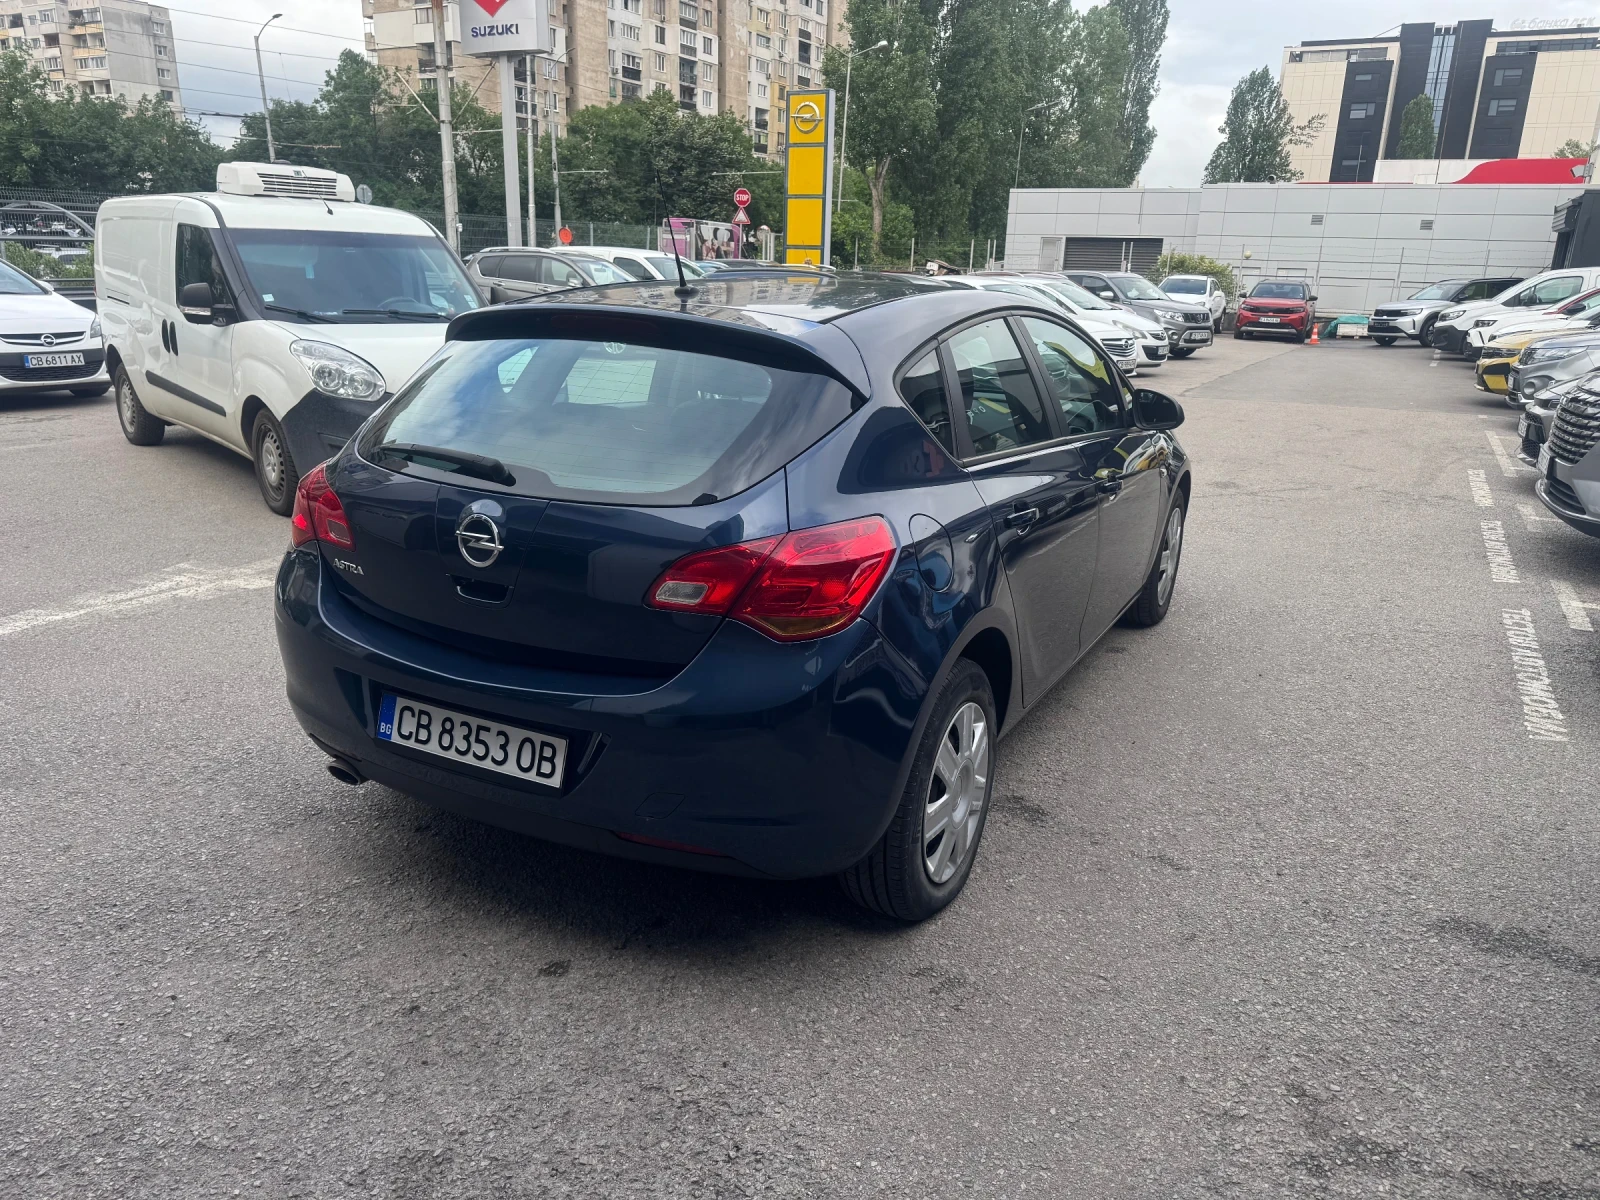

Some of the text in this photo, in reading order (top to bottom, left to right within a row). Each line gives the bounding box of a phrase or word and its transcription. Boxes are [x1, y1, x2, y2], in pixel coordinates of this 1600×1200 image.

[471, 23, 519, 38] SUZUKI
[735, 194, 749, 202] STOP
[30, 356, 44, 366] CB
[45, 355, 68, 365] 6811
[70, 354, 83, 364] AX
[333, 558, 364, 575] ASTRA
[380, 722, 392, 734] BG
[397, 705, 432, 745] CB
[438, 717, 509, 766] 8353
